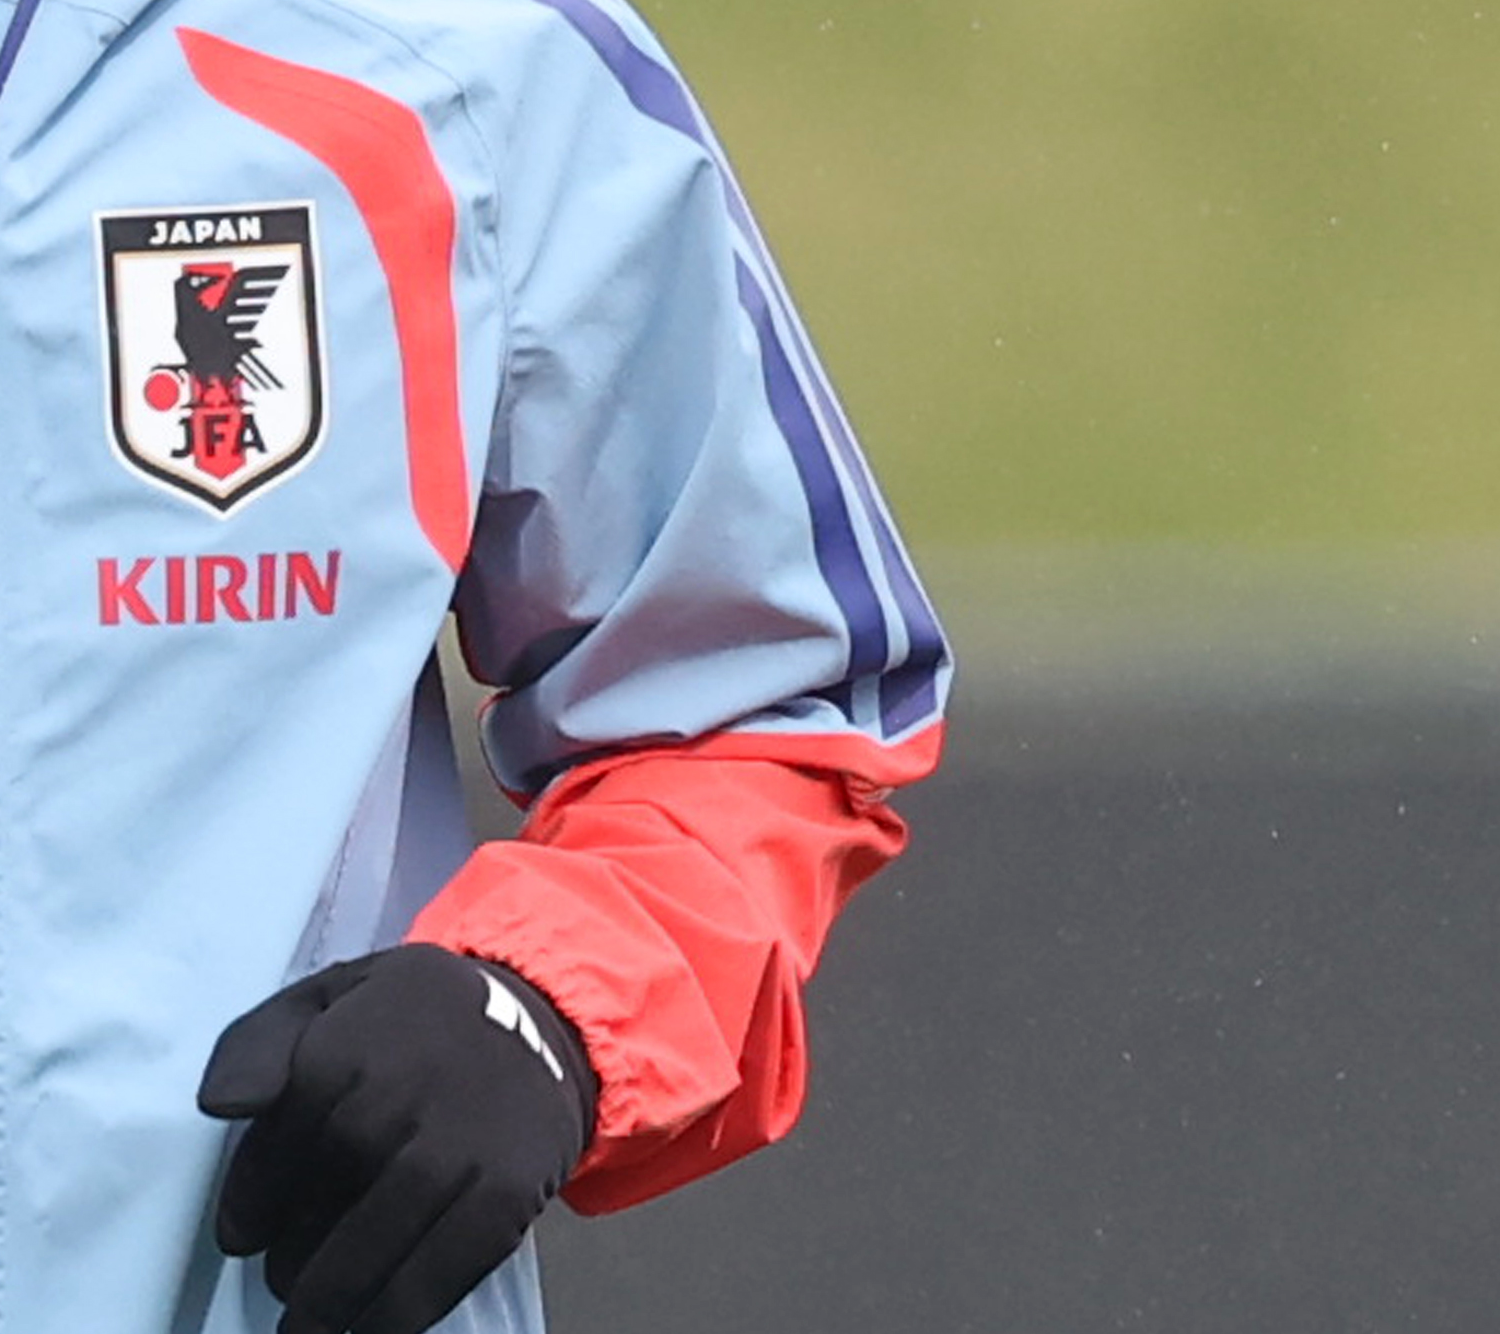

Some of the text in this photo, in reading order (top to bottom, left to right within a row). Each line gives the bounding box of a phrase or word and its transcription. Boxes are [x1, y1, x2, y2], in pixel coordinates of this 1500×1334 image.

[148, 216, 262, 245] JAPAN
[170, 414, 267, 459] JFA
[96, 549, 341, 627] KIRIN
